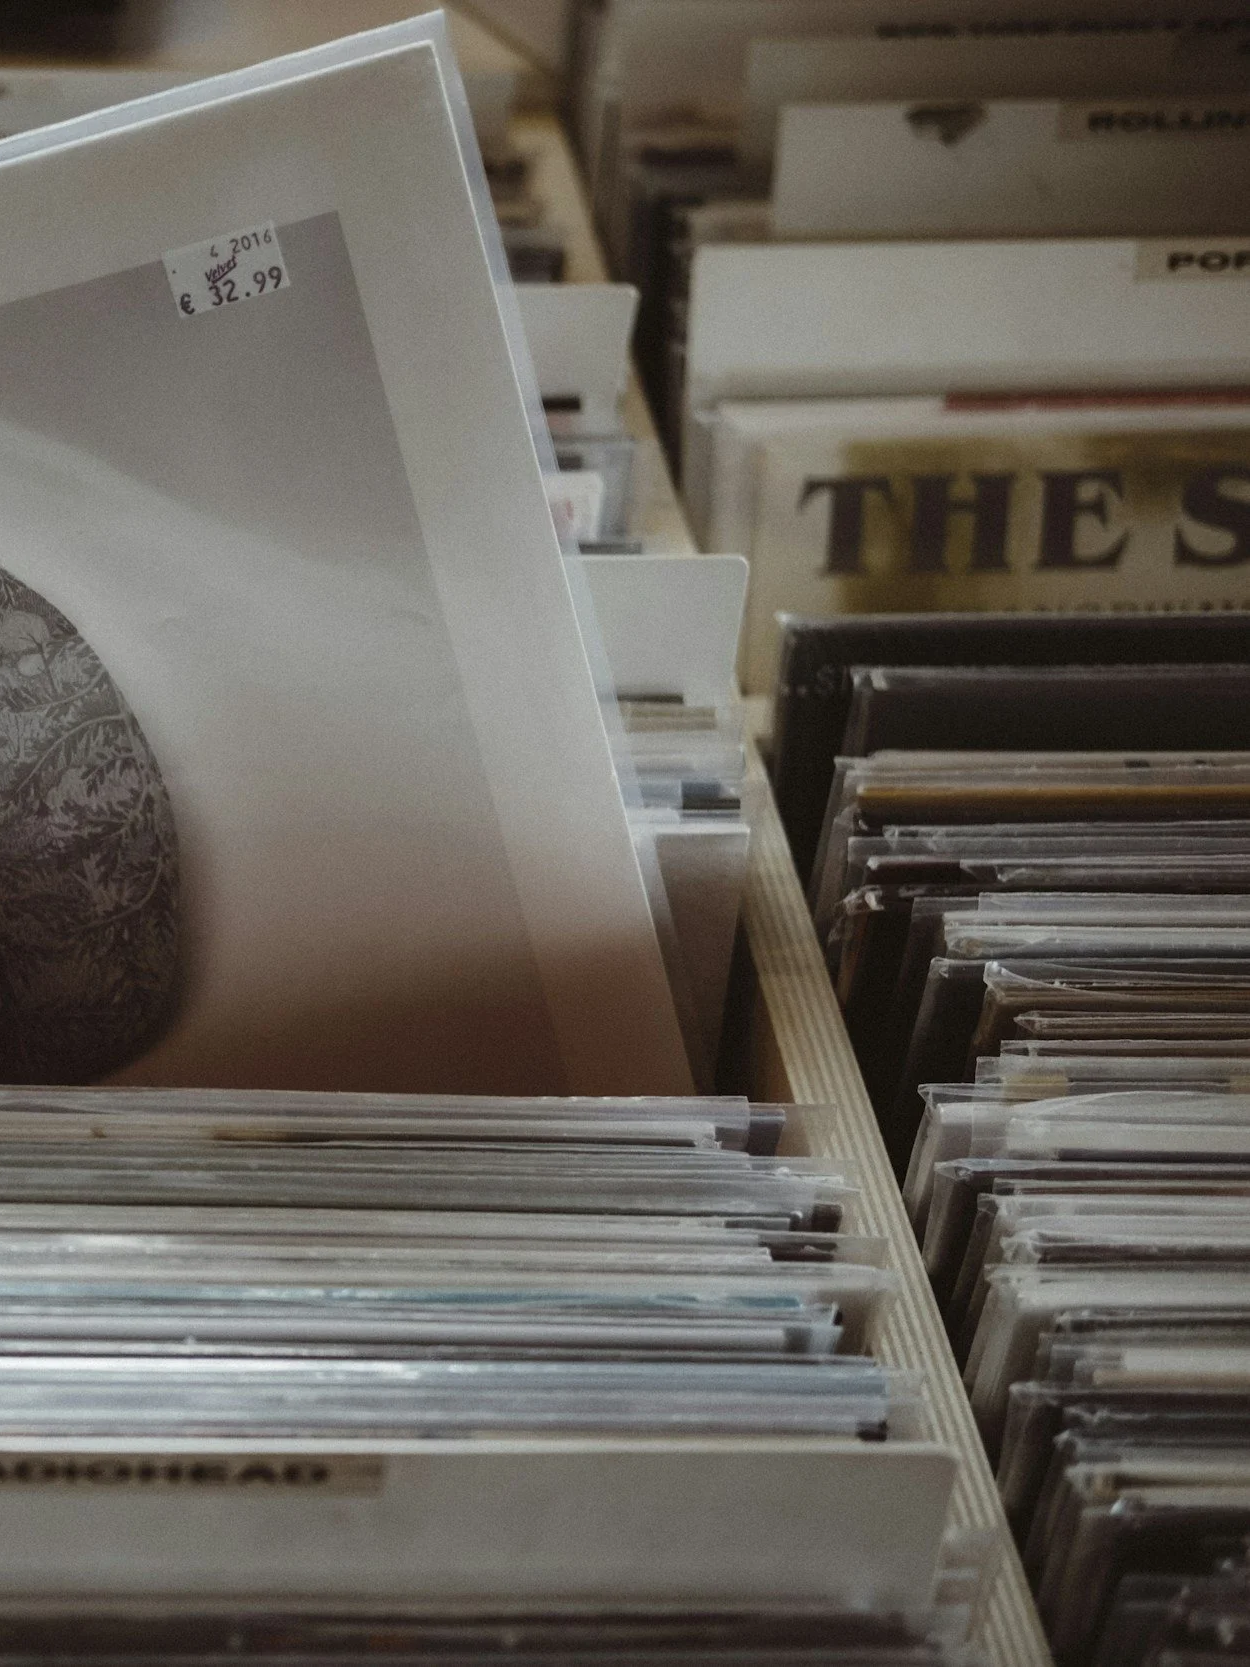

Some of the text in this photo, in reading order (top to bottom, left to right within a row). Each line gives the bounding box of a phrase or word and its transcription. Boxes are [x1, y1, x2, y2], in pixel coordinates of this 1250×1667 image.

[229, 229, 272, 254] 2016
[179, 265, 282, 315] € 32.99
[797, 469, 1132, 578] THE
